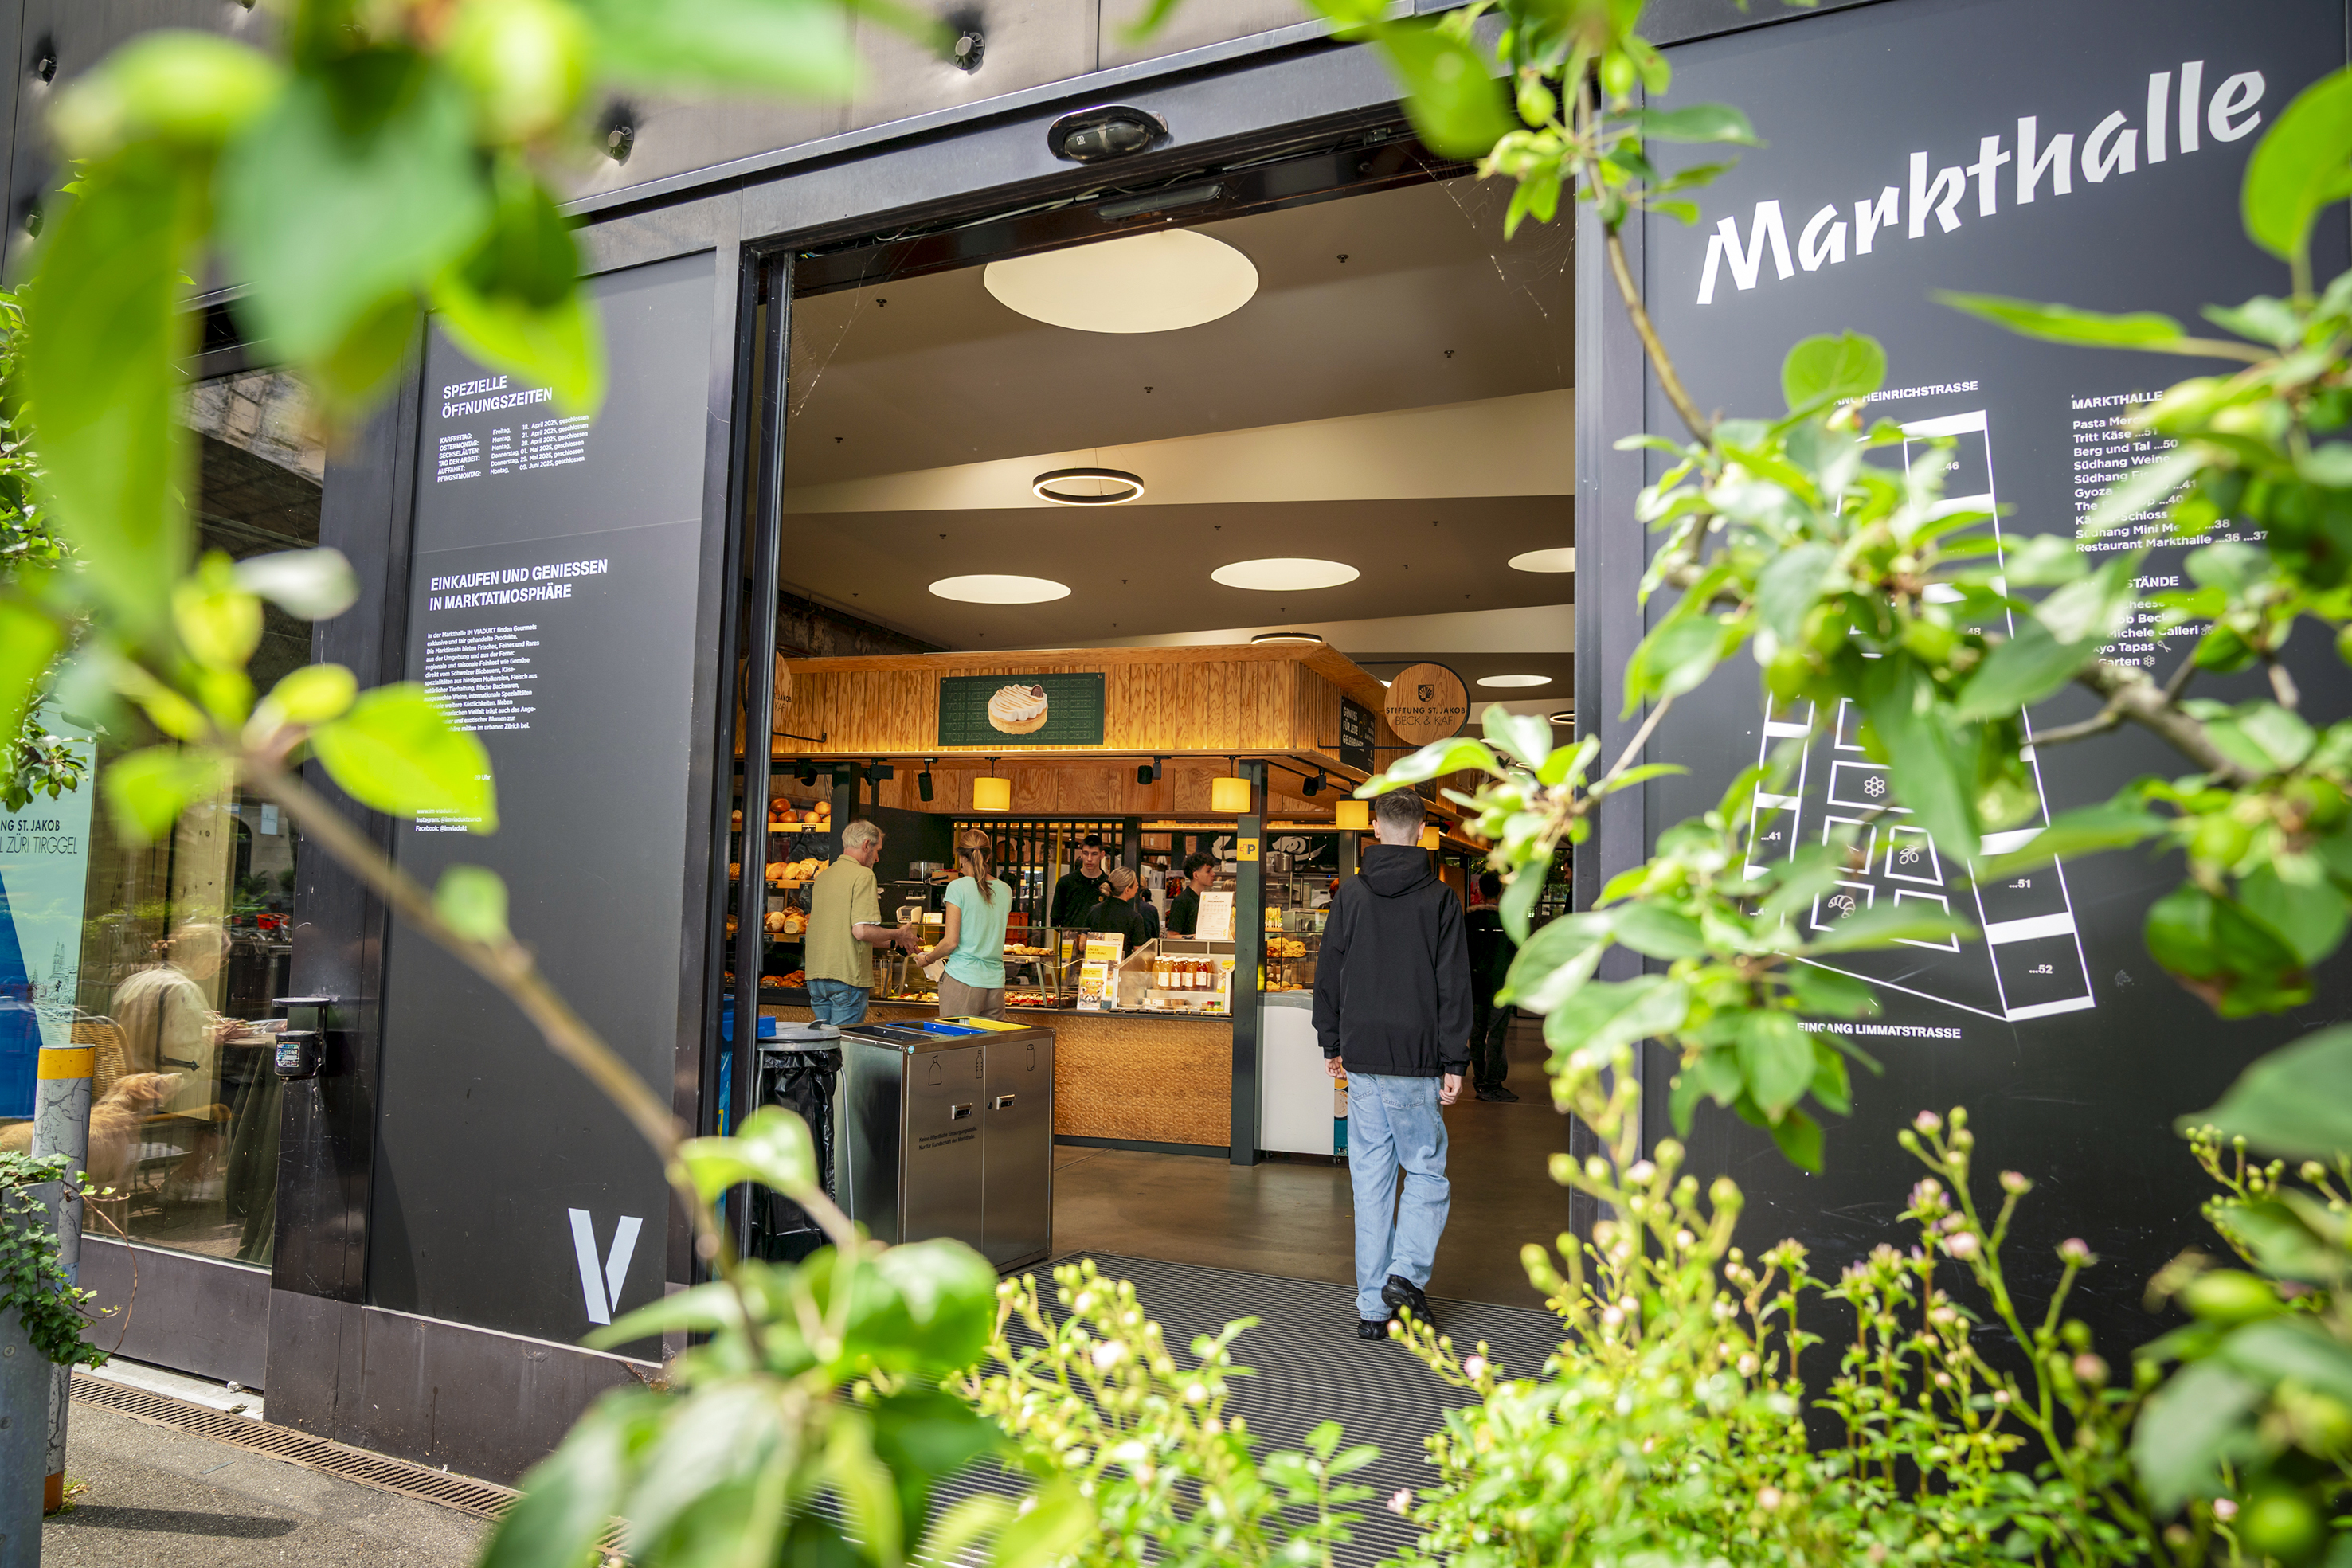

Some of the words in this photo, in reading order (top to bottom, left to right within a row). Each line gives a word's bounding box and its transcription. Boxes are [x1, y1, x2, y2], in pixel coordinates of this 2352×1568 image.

[1696, 59, 2265, 305] Markthalle
[443, 375, 507, 399] SPEZIELLE
[1862, 381, 1978, 402] HEINRICHSTRASSE
[441, 387, 553, 418] ÖFFNUNGSZEITEN
[2072, 391, 2162, 409] MARKTHALLE
[440, 433, 473, 444] KARFREITAG:
[531, 420, 542, 429] April
[558, 415, 589, 425] geschlossen
[2073, 419, 2106, 429] Pasta
[439, 448, 479, 459] SECHSELÄUTEN:
[530, 437, 542, 446] April
[558, 431, 588, 441] geschlossen
[440, 440, 479, 451] OSTERMONTAG:
[530, 429, 542, 438] April
[558, 423, 589, 433] geschlossen
[2073, 433, 2099, 443] Tritt
[2103, 431, 2131, 440] Käse
[460, 455, 480, 463] ARBEIT:
[554, 440, 584, 450] geschlossen
[2073, 448, 2103, 457] Berg
[2106, 443, 2129, 454] und
[2133, 441, 2150, 452] Tal
[437, 471, 481, 483] PFINGSTMONTAG:
[528, 461, 539, 470] Juni
[554, 456, 585, 466] geschlossen
[2074, 459, 2127, 471] Südhang
[2131, 455, 2170, 465] Weine
[2074, 473, 2127, 484] Südhang
[2075, 487, 2113, 499] Gyoza
[2075, 502, 2097, 511] The
[2134, 524, 2159, 534] Mini
[2076, 541, 2142, 552] Restaurant
[2146, 534, 2212, 548] Markthalle
[430, 571, 499, 591] EINKAUFEN
[502, 567, 529, 584] UND
[532, 559, 608, 580] GENIESSEN
[429, 597, 441, 611] IN
[444, 583, 572, 609] MARKTATMOSPHÄRE
[2118, 643, 2154, 653] Tapas
[2099, 657, 2140, 667] Garten
[1395, 716, 1420, 725] BECK
[1423, 716, 1432, 725] &
[1434, 716, 1455, 725] KAFI
[18, 819, 29, 831] ST.
[30, 819, 61, 831] JAKOB
[6, 833, 29, 854] ZÜRI
[33, 836, 77, 854] TIRGGEL
[1855, 1024, 1962, 1038] LIMMATSTRASSE
